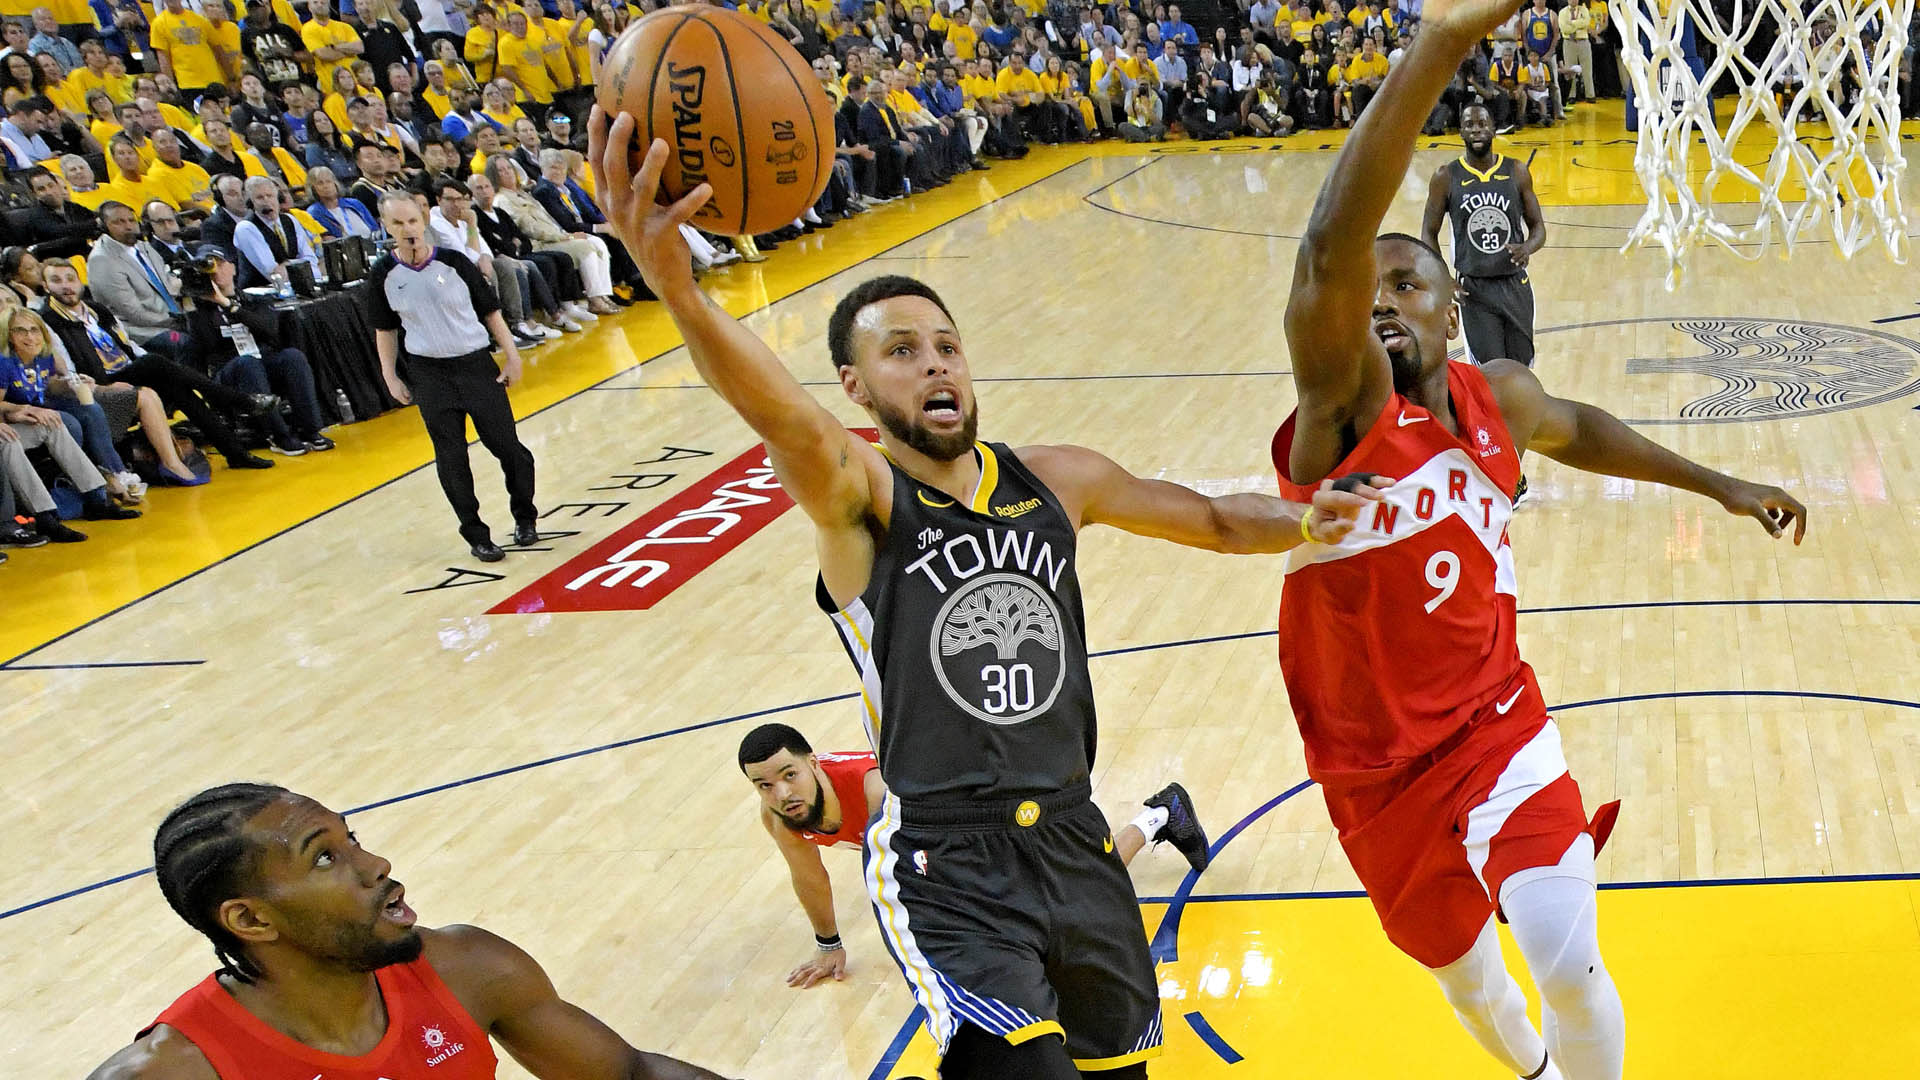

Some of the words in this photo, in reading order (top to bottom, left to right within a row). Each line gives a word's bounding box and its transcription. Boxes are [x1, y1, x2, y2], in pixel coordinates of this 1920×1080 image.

[772, 120, 797, 140] 20
[1460, 192, 1510, 213] TOWN
[1481, 233, 1500, 250] 23
[994, 498, 1043, 518] Rakuten
[563, 455, 786, 591] RACLE
[917, 527, 944, 549] The
[904, 528, 1067, 594] TOWN
[1423, 550, 1461, 615] 9
[980, 663, 1035, 714] 30
[1019, 807, 1039, 821] W
[426, 1053, 447, 1068] Sun
[444, 1042, 465, 1058] Life
